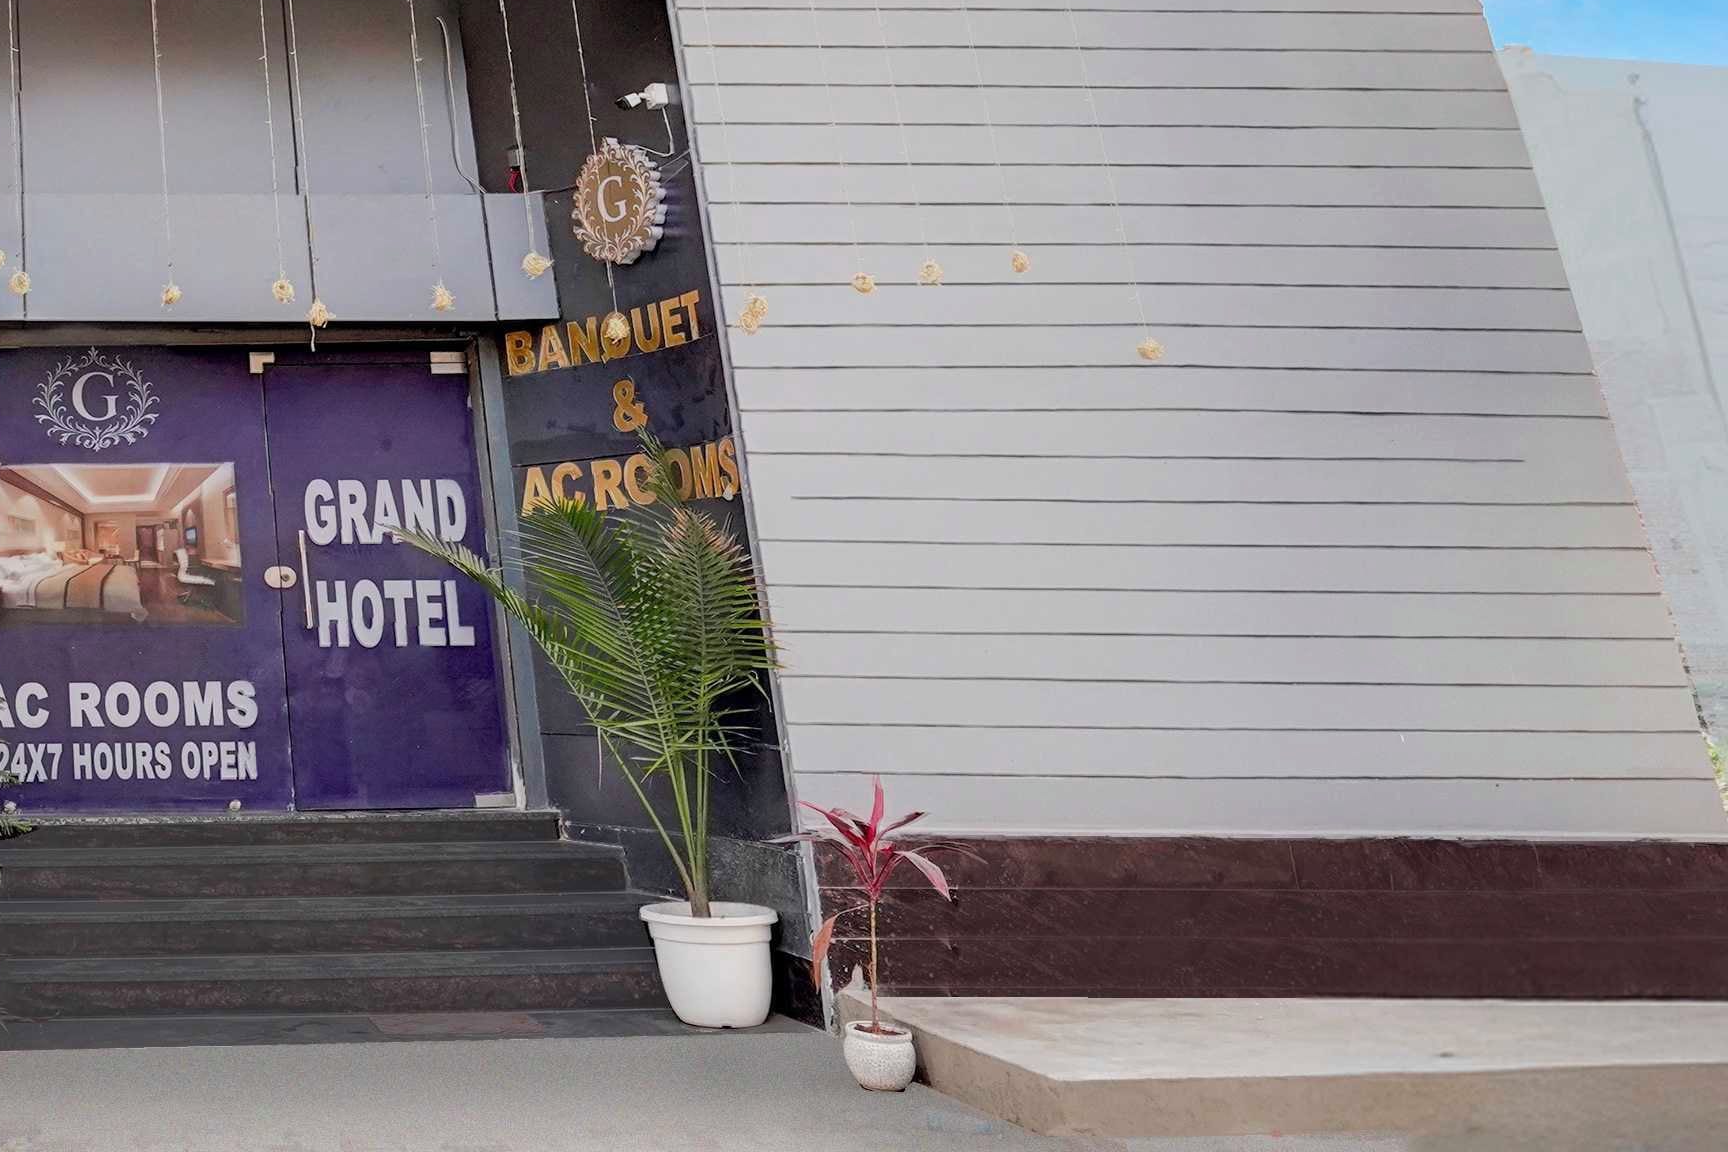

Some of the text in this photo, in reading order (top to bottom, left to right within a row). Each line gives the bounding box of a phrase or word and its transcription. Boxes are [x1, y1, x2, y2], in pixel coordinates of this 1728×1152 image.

[597, 174, 628, 223] G
[505, 289, 700, 376] BANQUET
[71, 371, 118, 422] G
[612, 377, 649, 433] &
[522, 437, 742, 517] AC ROOMS
[304, 478, 468, 546] GRAND
[316, 579, 475, 648] HOTEL
[68, 680, 259, 729] ROOMS
[72, 741, 172, 781] HOURS
[181, 740, 259, 781] OPEN
